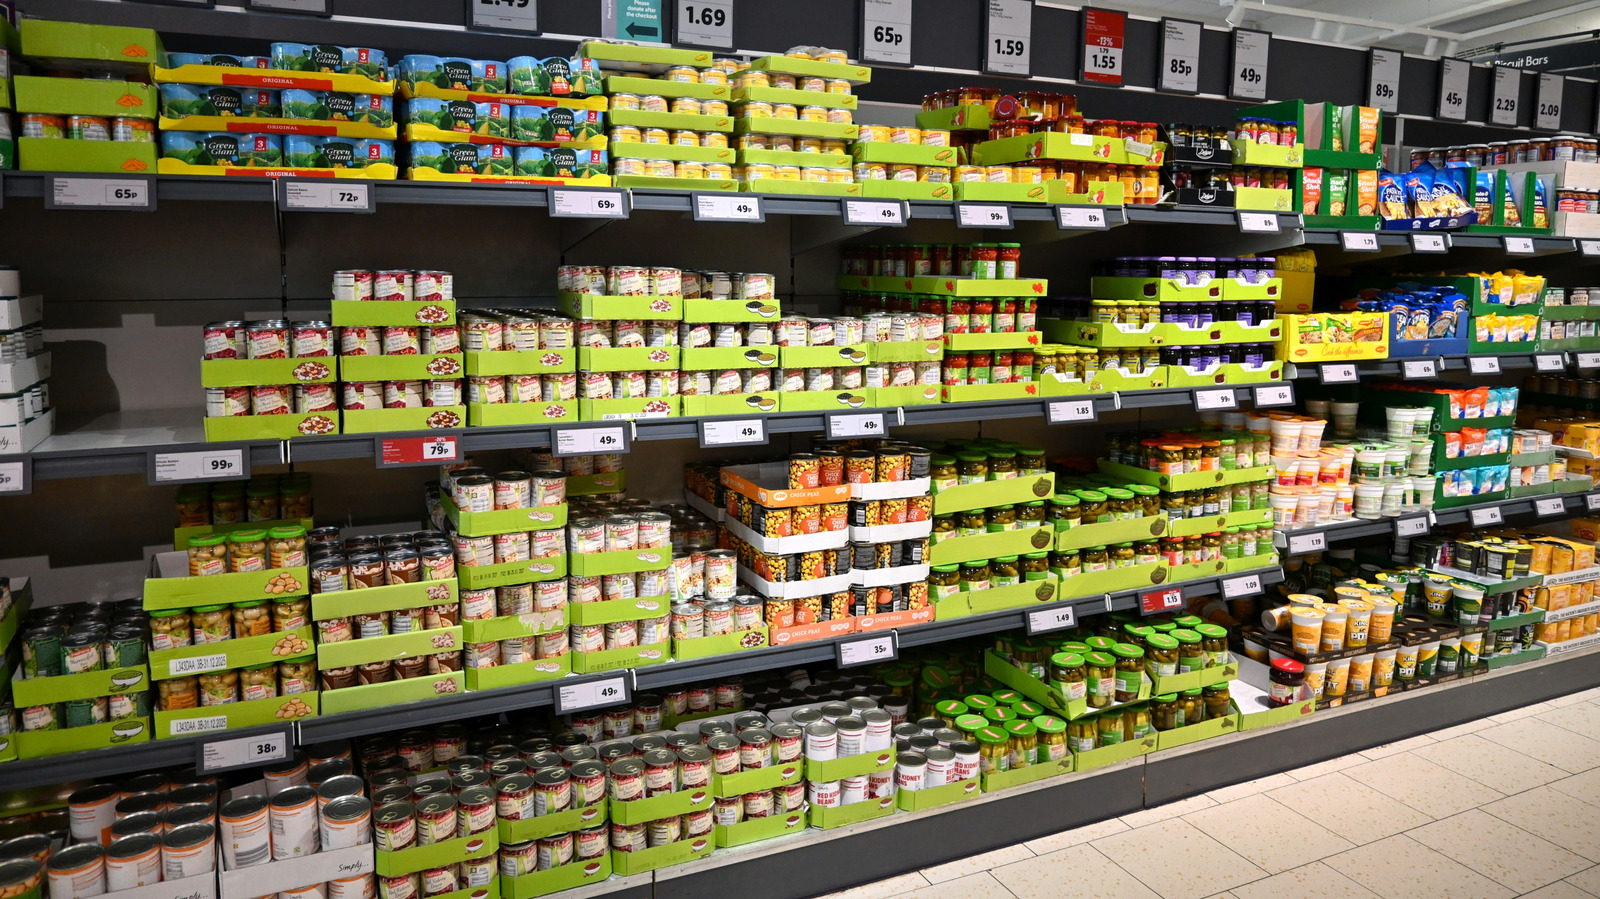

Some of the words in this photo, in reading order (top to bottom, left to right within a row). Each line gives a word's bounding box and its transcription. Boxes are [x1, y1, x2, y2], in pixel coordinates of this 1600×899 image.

[685, 6, 726, 27] 1.69
[873, 25, 903, 46] 65p
[1097, 36, 1114, 47] -13%
[994, 38, 1025, 56] 1.59
[314, 50, 339, 61] Green
[360, 52, 367, 60] 3
[259, 61, 266, 69] 3
[316, 56, 342, 66] Giant
[1092, 54, 1116, 69] 1.55
[1525, 55, 1549, 67] Bars
[447, 66, 469, 75] Green
[488, 68, 494, 76] 3
[1170, 59, 1192, 76] 85p
[449, 71, 471, 80] Giant
[1240, 68, 1262, 84] 49p
[1375, 83, 1394, 99] 89p
[260, 94, 267, 102] 3
[373, 98, 379, 106] 3
[1446, 92, 1463, 107] 45p
[452, 105, 474, 114] Green
[1496, 98, 1516, 112] 2.29
[453, 110, 475, 119] Giant
[492, 107, 498, 115] 3
[1540, 104, 1559, 117] 2.09
[551, 112, 572, 121] Green
[590, 112, 596, 120] 3
[553, 117, 573, 126] Giant
[208, 142, 235, 151] Green
[257, 140, 264, 148] 3
[210, 148, 237, 156] Giant
[326, 148, 351, 156] Green
[371, 148, 378, 156] 3
[452, 149, 475, 158] Green
[494, 147, 501, 155] 3
[328, 153, 352, 161] Giant
[454, 154, 477, 162] Giant
[553, 153, 574, 162] Green
[593, 153, 599, 161] 3
[555, 159, 576, 167] Giant
[1303, 176, 1322, 185] Snack
[114, 188, 138, 199] 65p
[339, 192, 359, 202] 72p
[597, 200, 615, 209] 69p
[736, 204, 752, 214] 49p
[881, 209, 896, 218] 49p
[990, 213, 1004, 221] 99p
[1088, 214, 1100, 223] 89p
[1076, 406, 1090, 416] 1.85
[863, 420, 878, 430] 49p
[741, 427, 757, 437] 49p
[599, 435, 617, 444] 49p
[430, 445, 449, 455] 79p
[211, 459, 233, 470] 99p
[1310, 537, 1322, 547] 1.19
[1245, 580, 1258, 590] 1.09
[1428, 602, 1446, 610] POT
[1056, 613, 1070, 622] 1.49
[874, 645, 887, 654] 35p
[601, 687, 618, 697] 49p
[256, 743, 277, 755] 38p
[873, 776, 891, 784] KIDNEY
